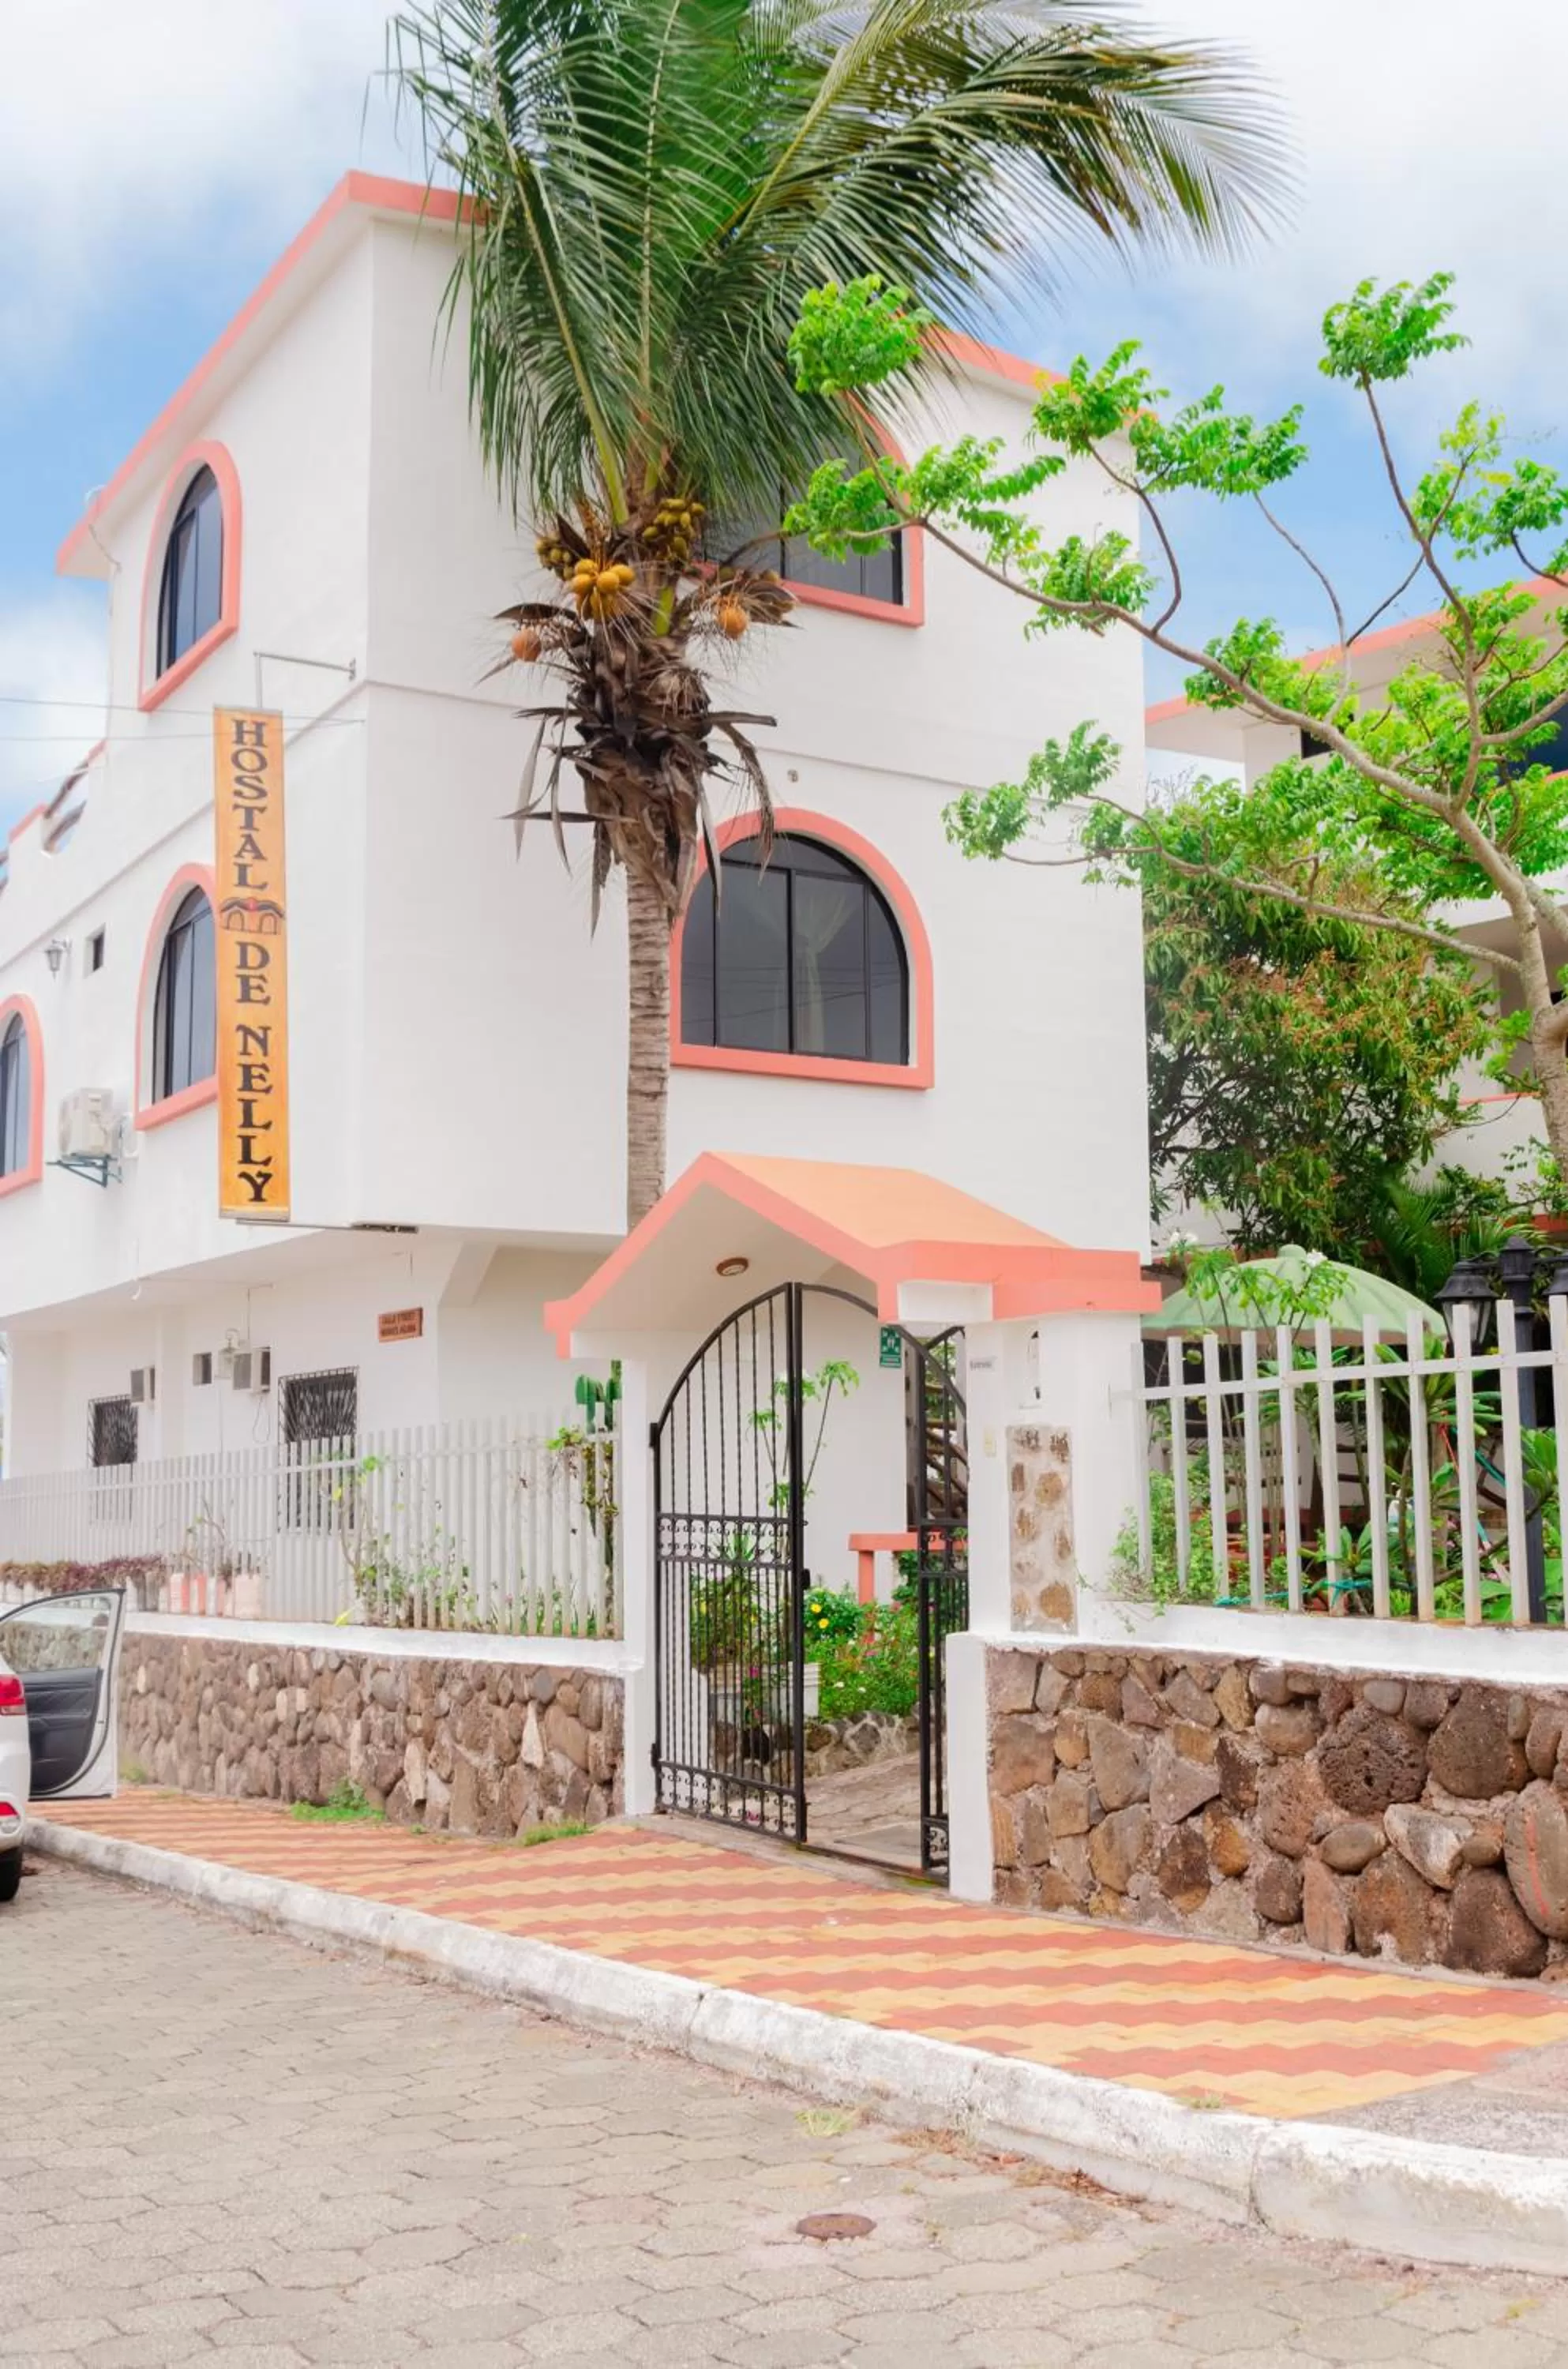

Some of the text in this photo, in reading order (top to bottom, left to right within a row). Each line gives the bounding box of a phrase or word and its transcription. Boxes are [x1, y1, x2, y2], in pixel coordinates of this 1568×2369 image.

[231, 719, 273, 1203] HOSTAL DE NELLY
